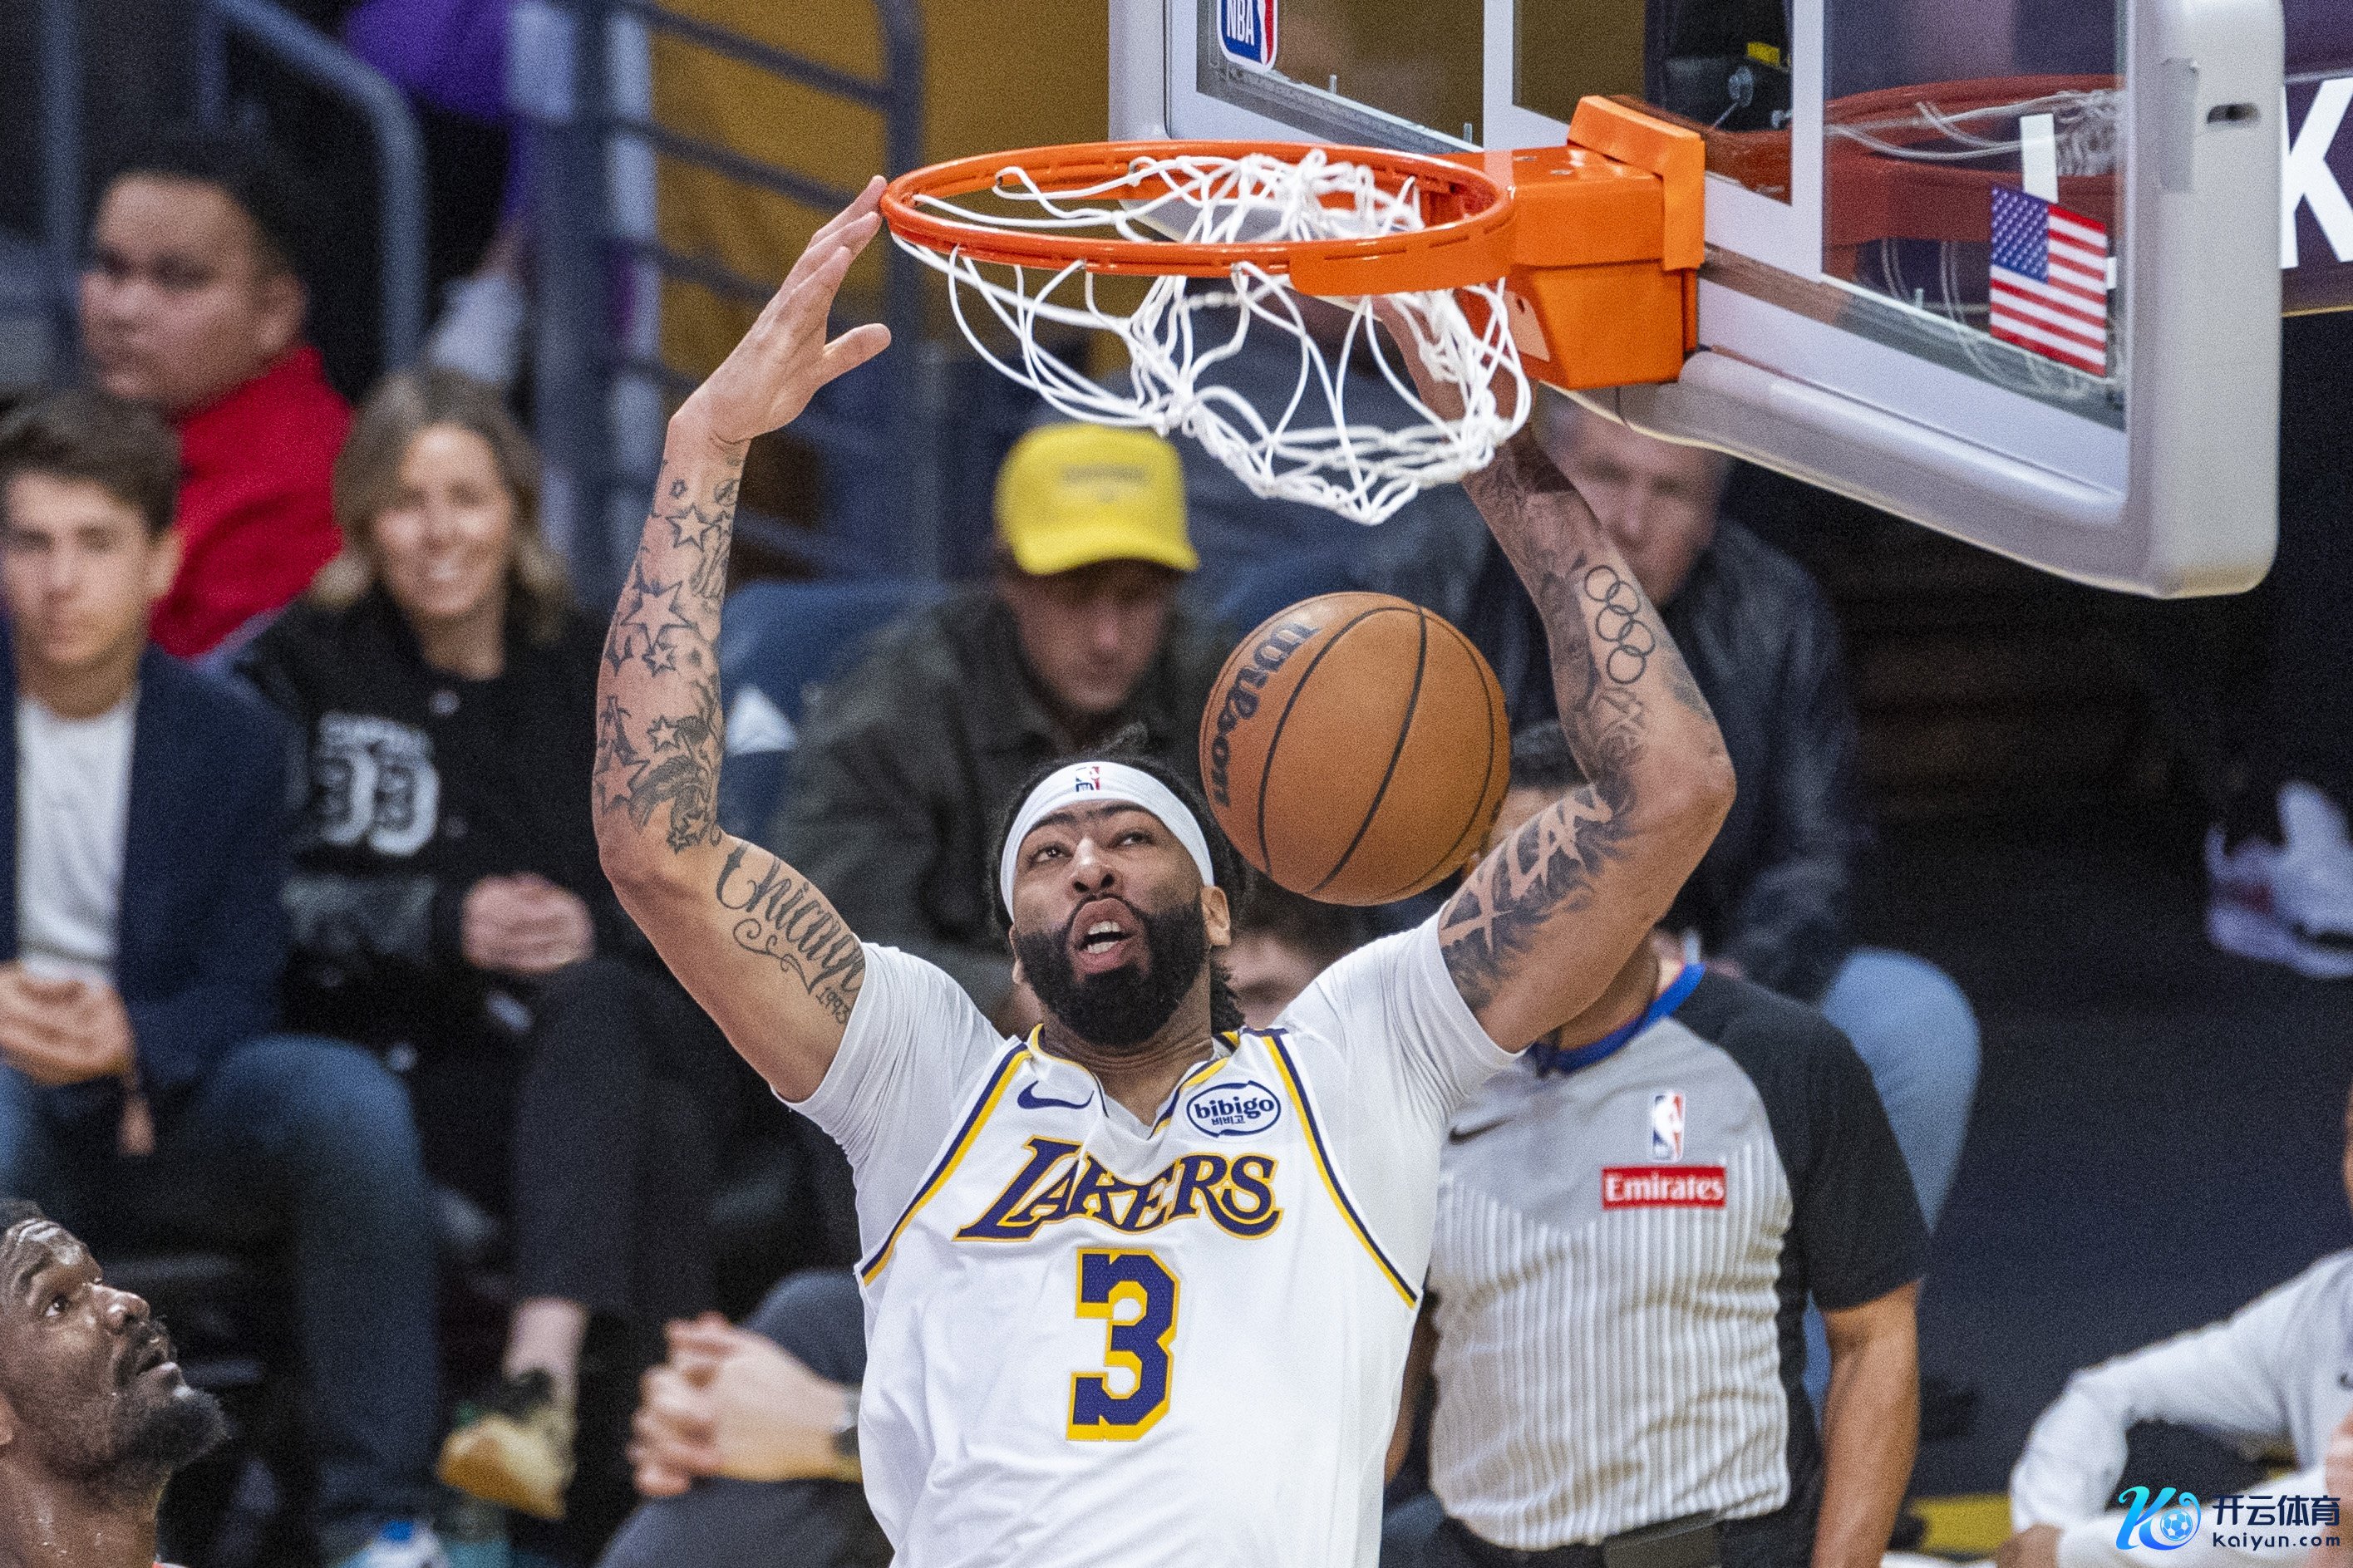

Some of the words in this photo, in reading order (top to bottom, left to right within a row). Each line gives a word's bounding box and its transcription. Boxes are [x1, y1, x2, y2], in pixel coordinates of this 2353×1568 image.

[1226, 0, 1255, 47] NBA
[1194, 1096, 1275, 1119] bibigo
[1210, 1114, 1246, 1126] 비비고
[953, 1135, 1284, 1241] LAKERS
[1605, 1170, 1725, 1202] Emirates
[1066, 1247, 1181, 1442] 3
